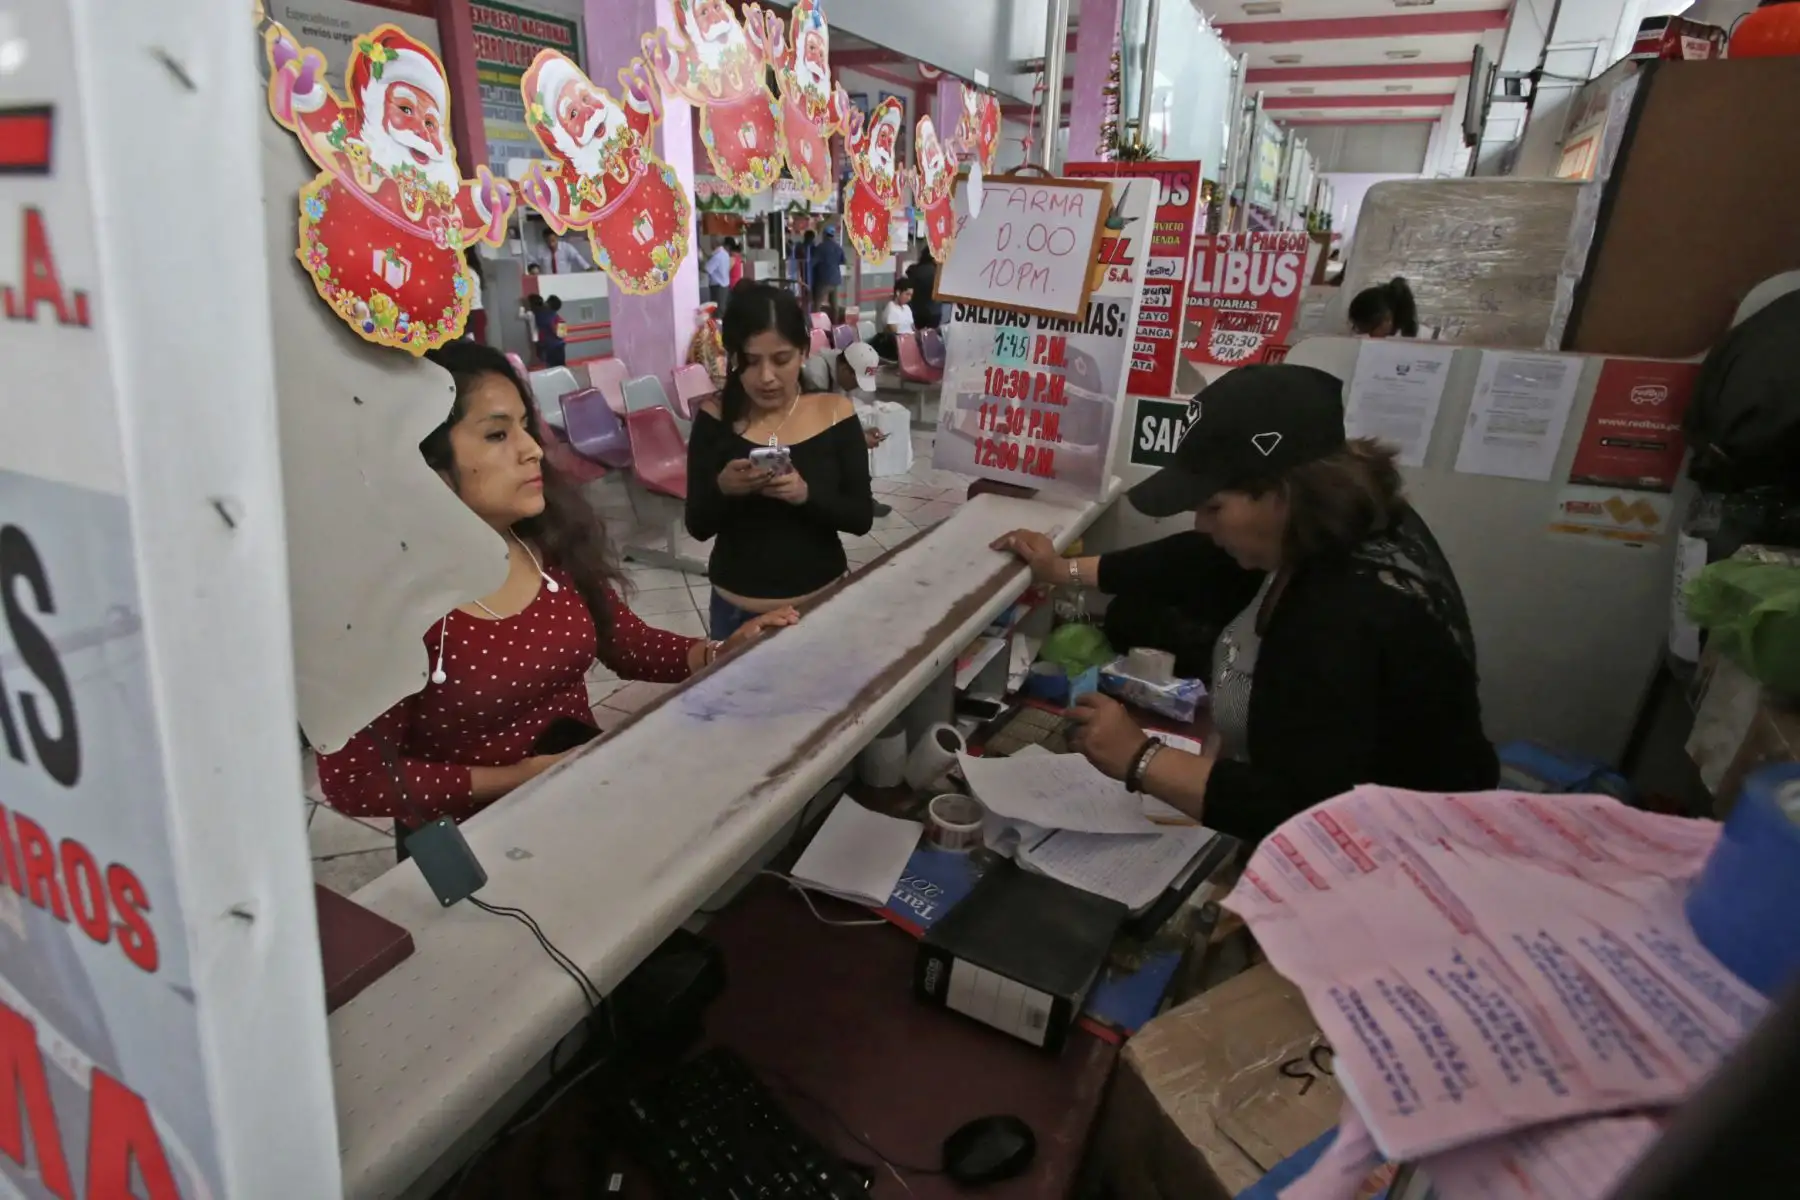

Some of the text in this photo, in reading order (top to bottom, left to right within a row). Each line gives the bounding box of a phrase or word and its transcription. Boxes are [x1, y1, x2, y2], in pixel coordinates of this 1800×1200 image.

[981, 186, 1084, 217] TARMA
[997, 222, 1076, 256] 0.00
[1109, 267, 1133, 283] S.A.
[1187, 251, 1300, 297] LIBUS
[1213, 298, 1257, 309] DIARIAS
[1033, 334, 1069, 368] P.M.
[1214, 332, 1258, 348] 08:30
[1130, 361, 1153, 371] ATA
[984, 366, 1069, 407] 10:30 P.M.
[1028, 409, 1062, 443] P.M.
[974, 436, 1056, 479] 12:00 P.M.
[0, 803, 160, 973] IROS
